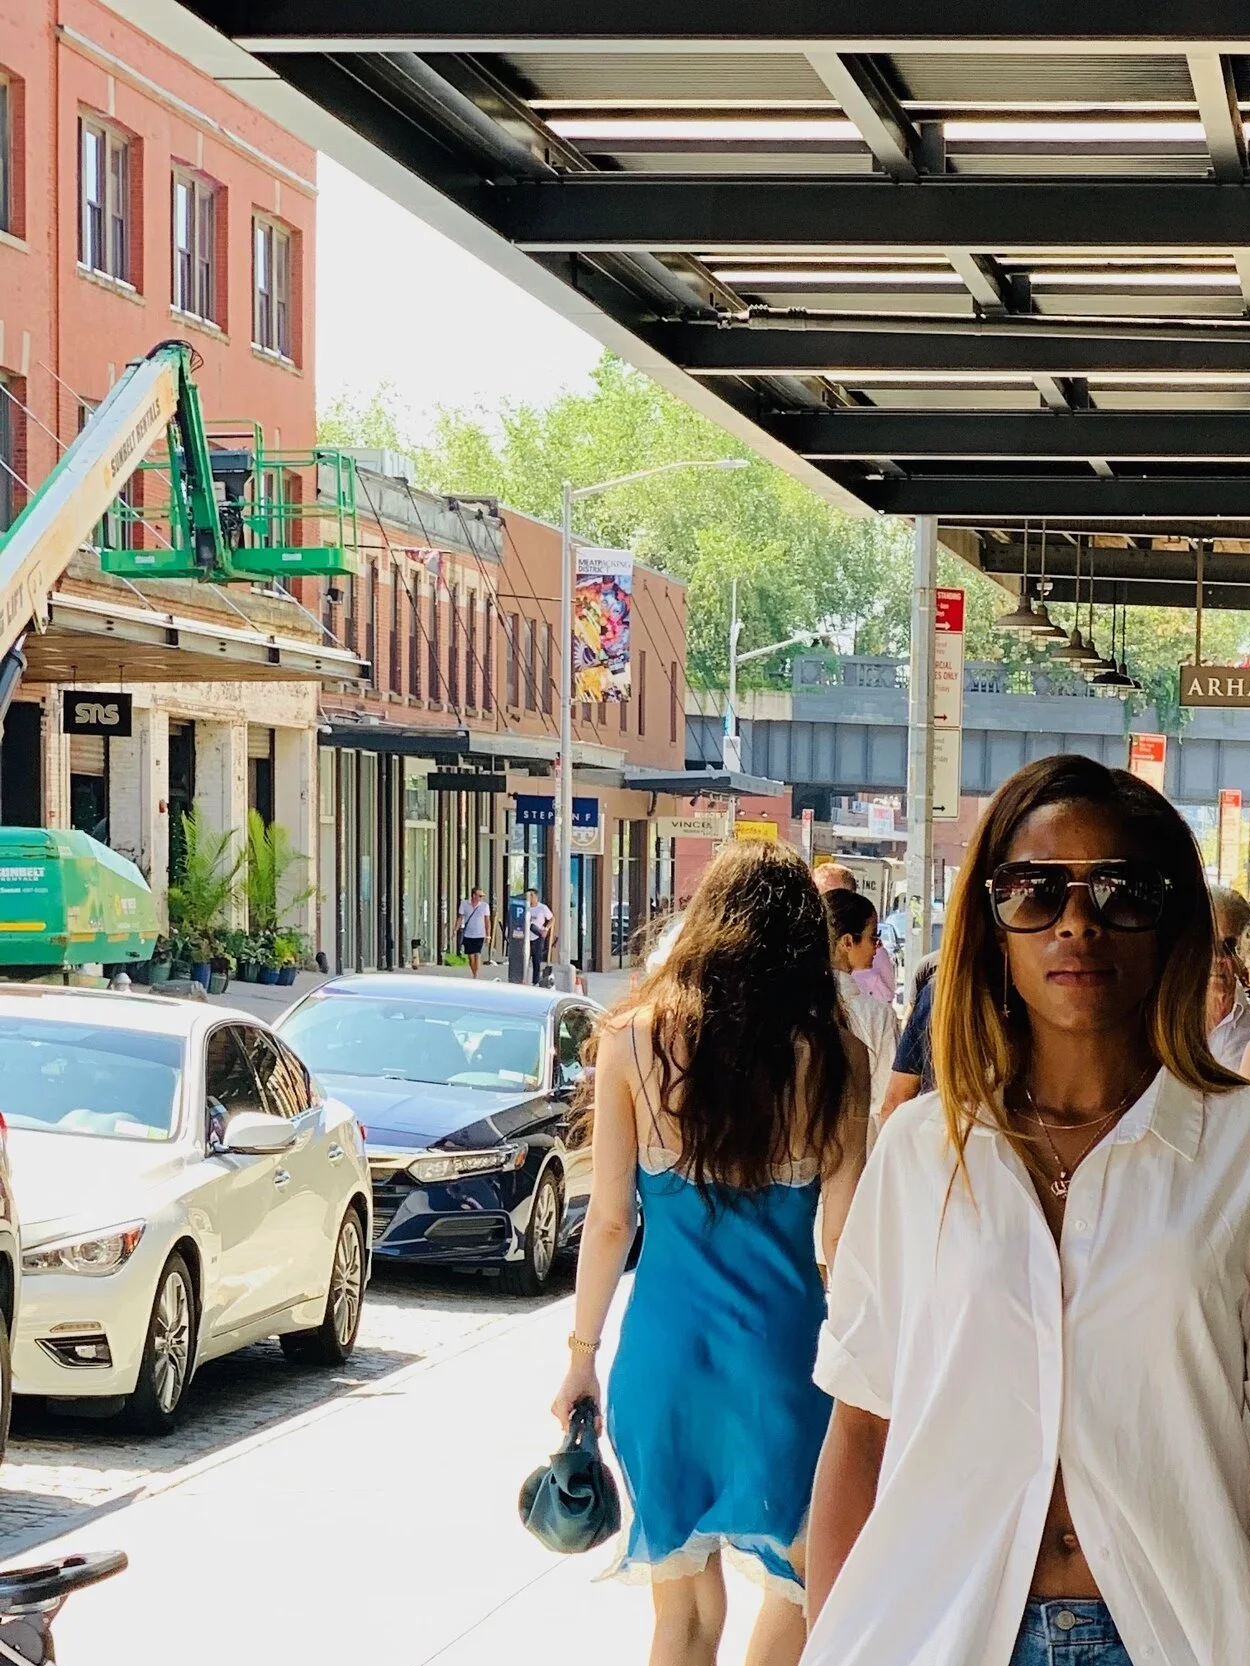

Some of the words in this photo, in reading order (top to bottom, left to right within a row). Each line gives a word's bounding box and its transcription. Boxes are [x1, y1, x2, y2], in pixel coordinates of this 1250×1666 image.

[110, 432, 137, 478] SUNBELT
[135, 400, 161, 443] RENTALS
[523, 811, 579, 821] STEPN
[516, 907, 524, 918] P
